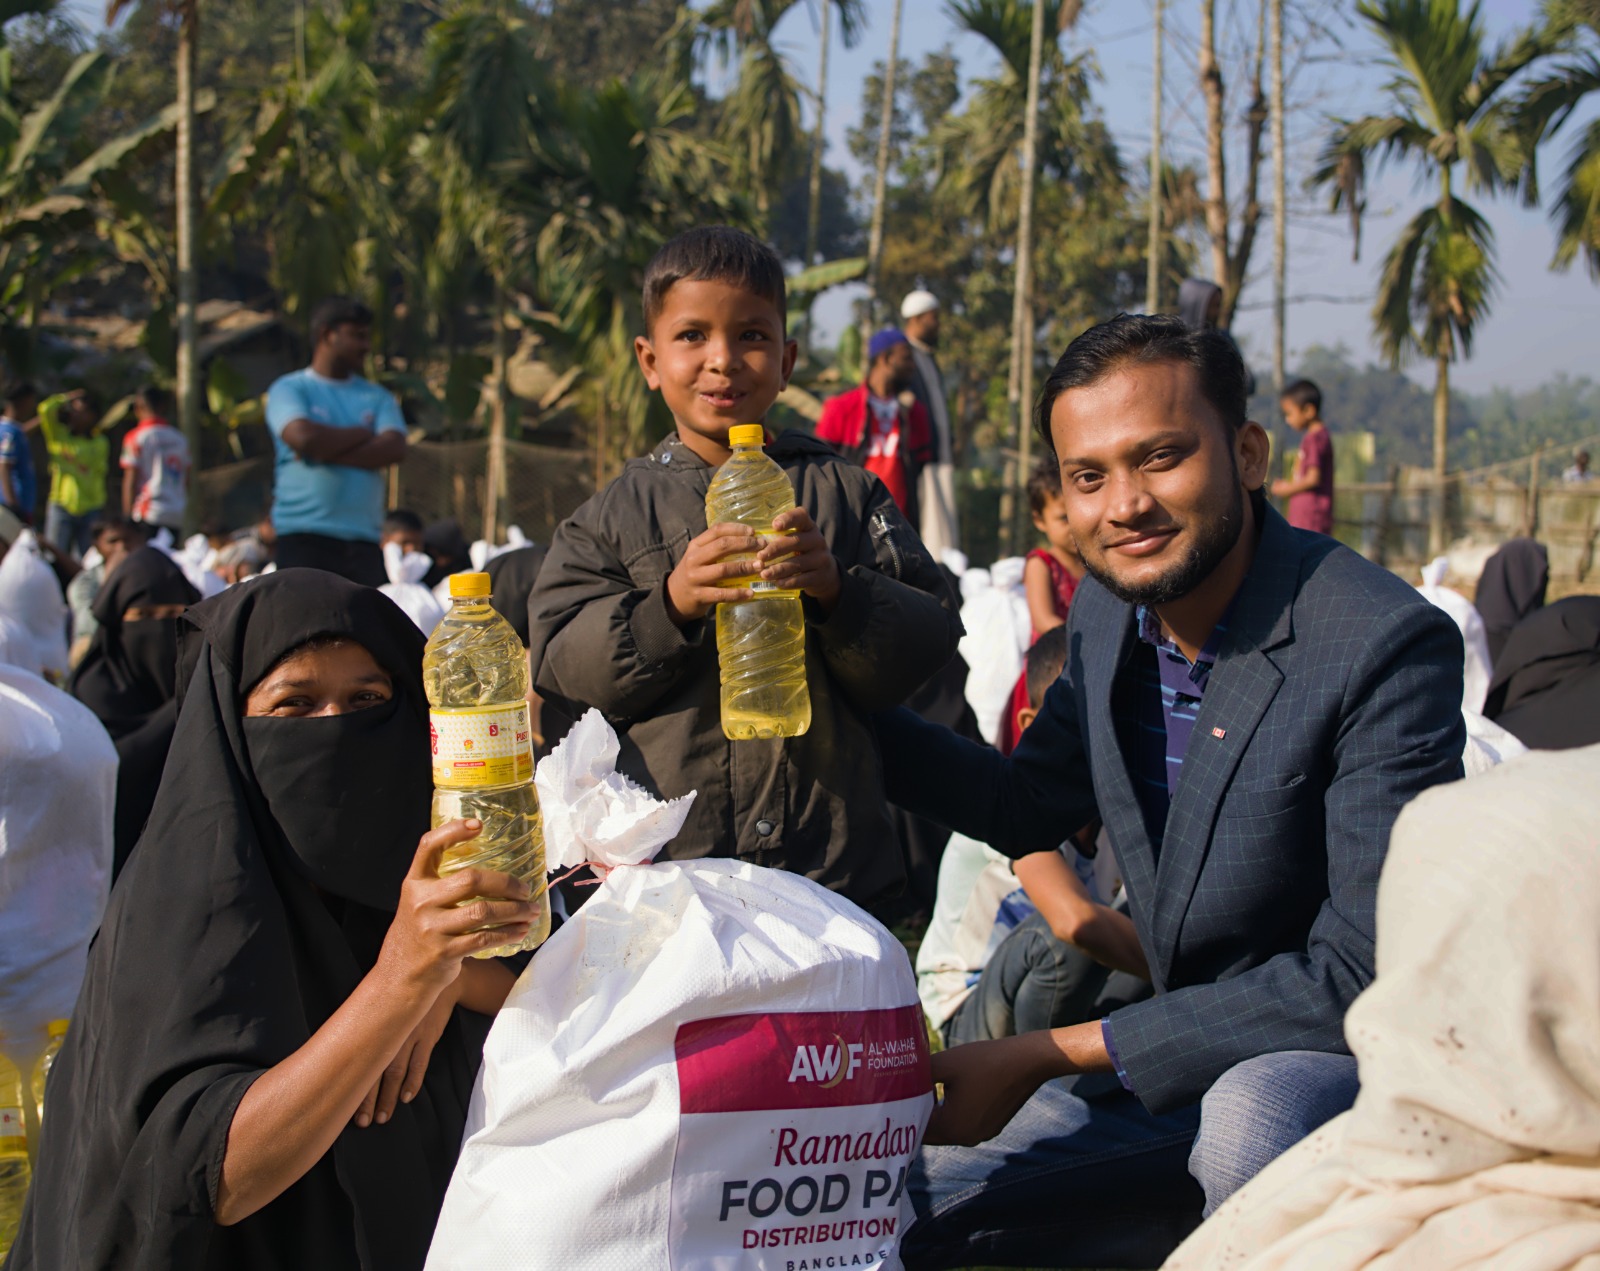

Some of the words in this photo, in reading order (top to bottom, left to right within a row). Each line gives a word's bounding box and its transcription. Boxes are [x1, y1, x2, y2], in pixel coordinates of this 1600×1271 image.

[787, 1043, 863, 1083] AWF
[867, 1053, 918, 1070] FOUNDATION
[774, 1117, 917, 1167] Ramadan
[719, 1173, 850, 1222] FOOD
[743, 1217, 897, 1249] DISTRIBUTION
